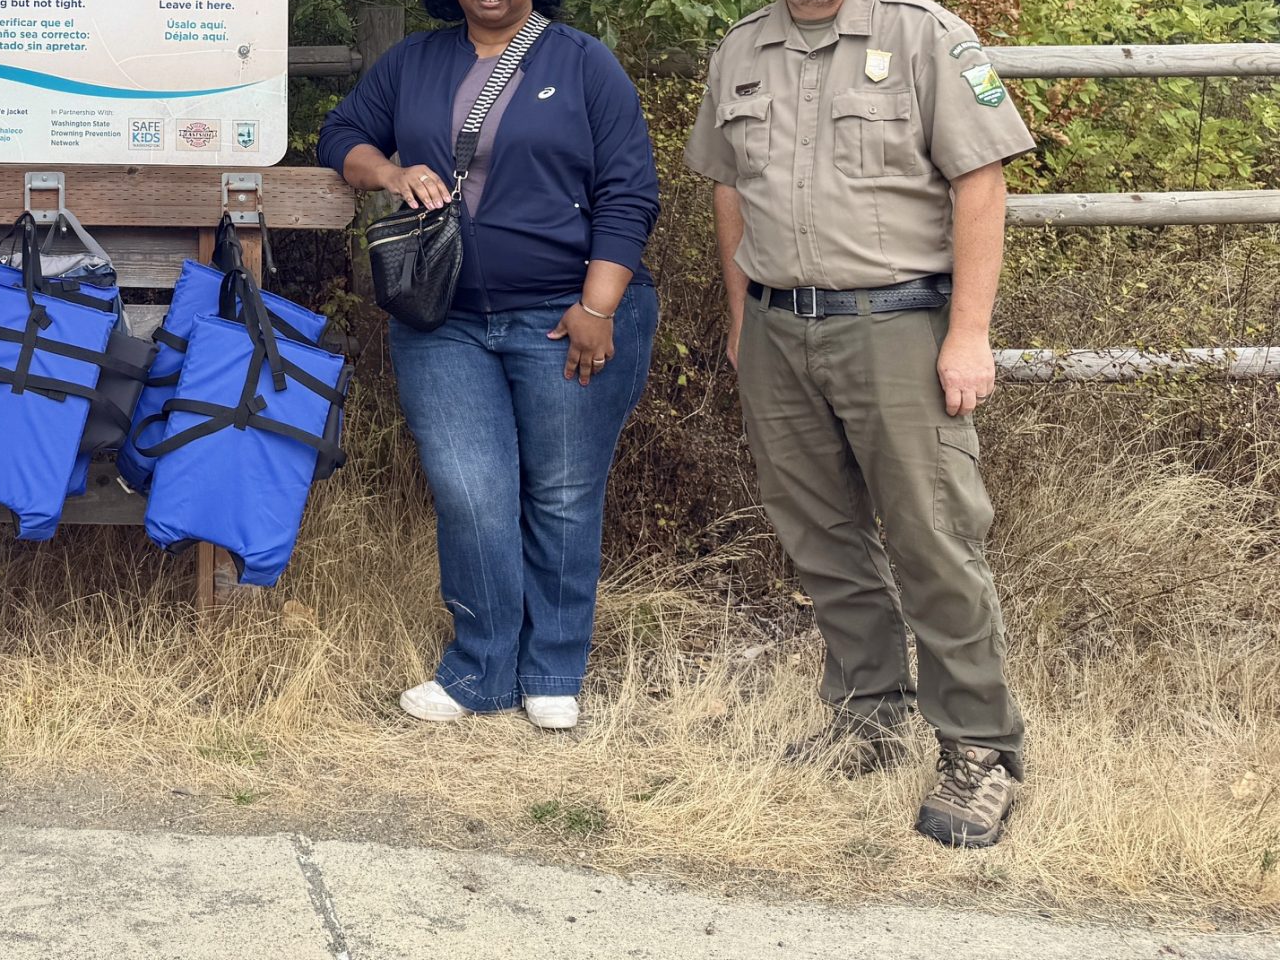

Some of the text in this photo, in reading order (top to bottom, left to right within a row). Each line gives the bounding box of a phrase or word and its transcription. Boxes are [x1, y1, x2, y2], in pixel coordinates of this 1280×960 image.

[33, 0, 52, 8] not
[159, 0, 234, 10] Leave it here.
[40, 20, 61, 28] que
[64, 18, 74, 28] el
[167, 18, 226, 30] Úsalo aquí.
[41, 30, 90, 40] correcto:
[164, 31, 229, 42] Déjalo aquí.
[27, 41, 42, 52] sin
[46, 42, 87, 52] apretar.
[132, 122, 160, 131] SAFE
